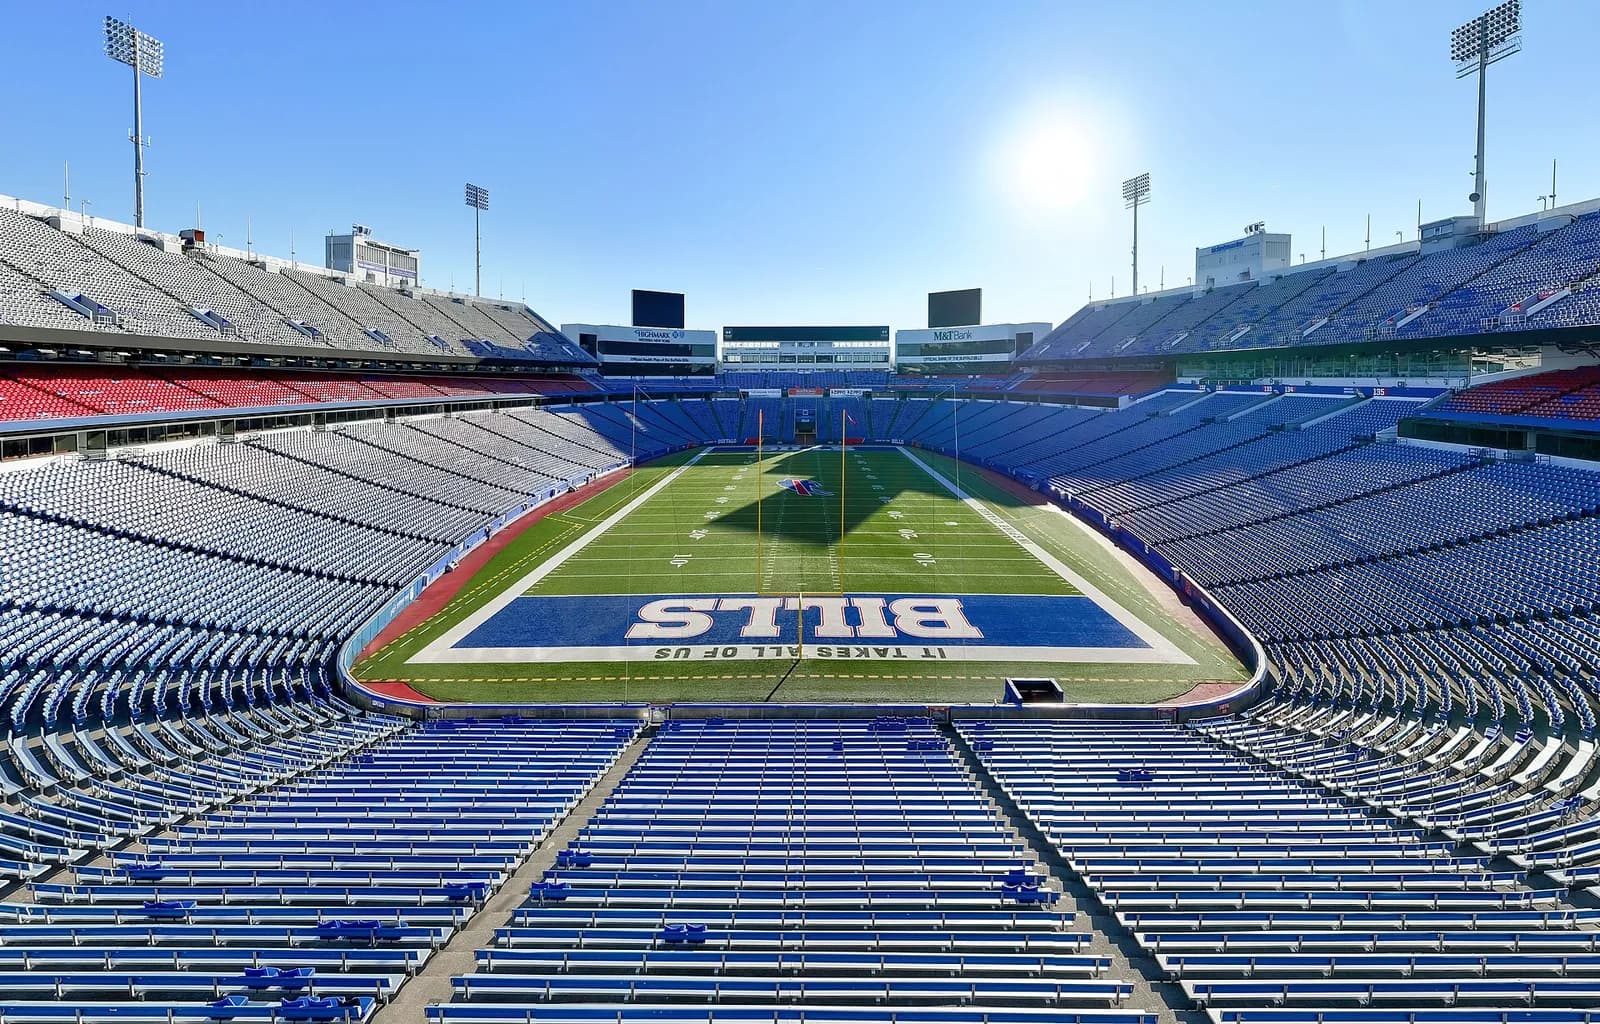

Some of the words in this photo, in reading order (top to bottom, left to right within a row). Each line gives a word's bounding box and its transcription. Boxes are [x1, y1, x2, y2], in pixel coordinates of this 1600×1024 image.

[635, 330, 671, 339] HIGHMARK
[933, 330, 954, 341] M&T
[954, 329, 973, 340] Bank
[1373, 388, 1385, 396] 135
[670, 554, 692, 565] 10
[912, 552, 936, 564] 10
[624, 597, 985, 639] BILLS
[654, 646, 691, 660] US
[703, 646, 739, 659] OF
[751, 645, 801, 659] ALL
[816, 646, 907, 659] TAKES
[920, 647, 947, 659] IT
